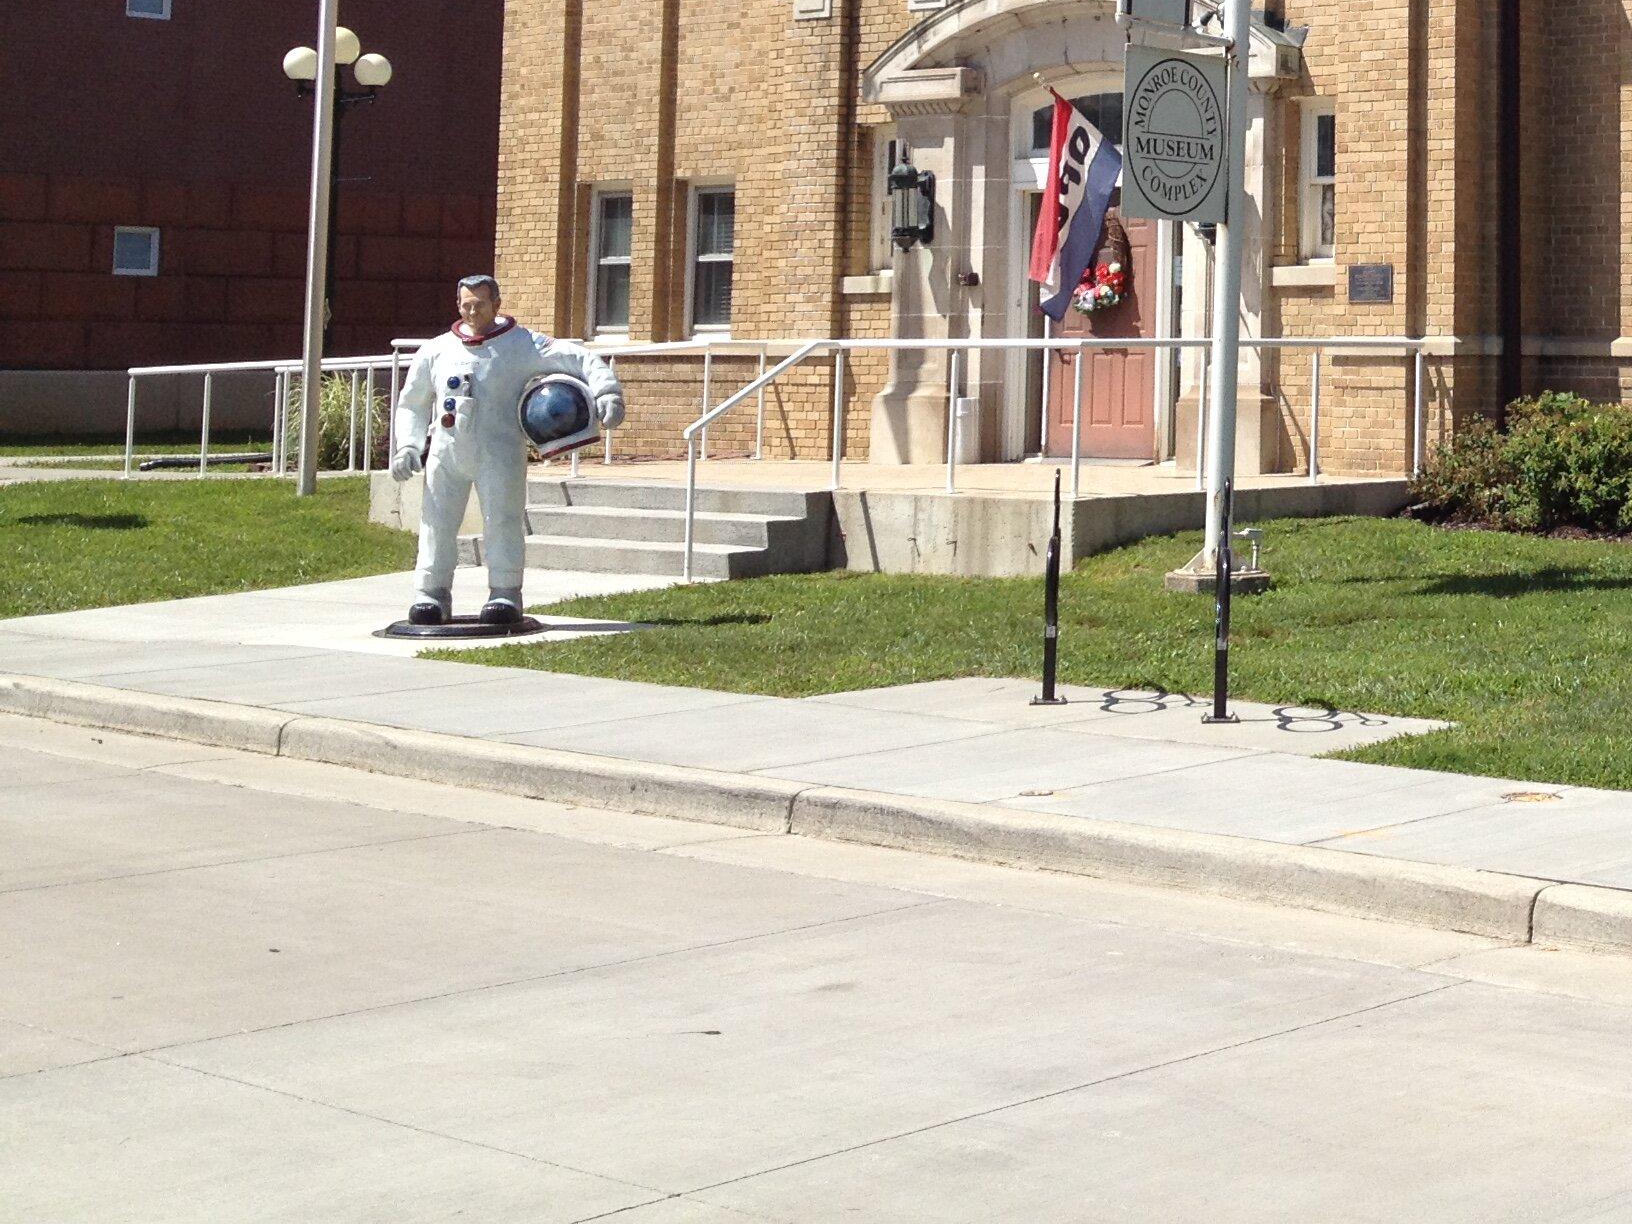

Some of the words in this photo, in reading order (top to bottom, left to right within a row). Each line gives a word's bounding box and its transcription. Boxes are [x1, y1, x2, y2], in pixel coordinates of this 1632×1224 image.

[1134, 66, 1179, 128] MONROE
[1180, 68, 1217, 136] COUNTY
[1136, 136, 1214, 161] MUSEUM
[1142, 165, 1208, 202] COMPLEX
